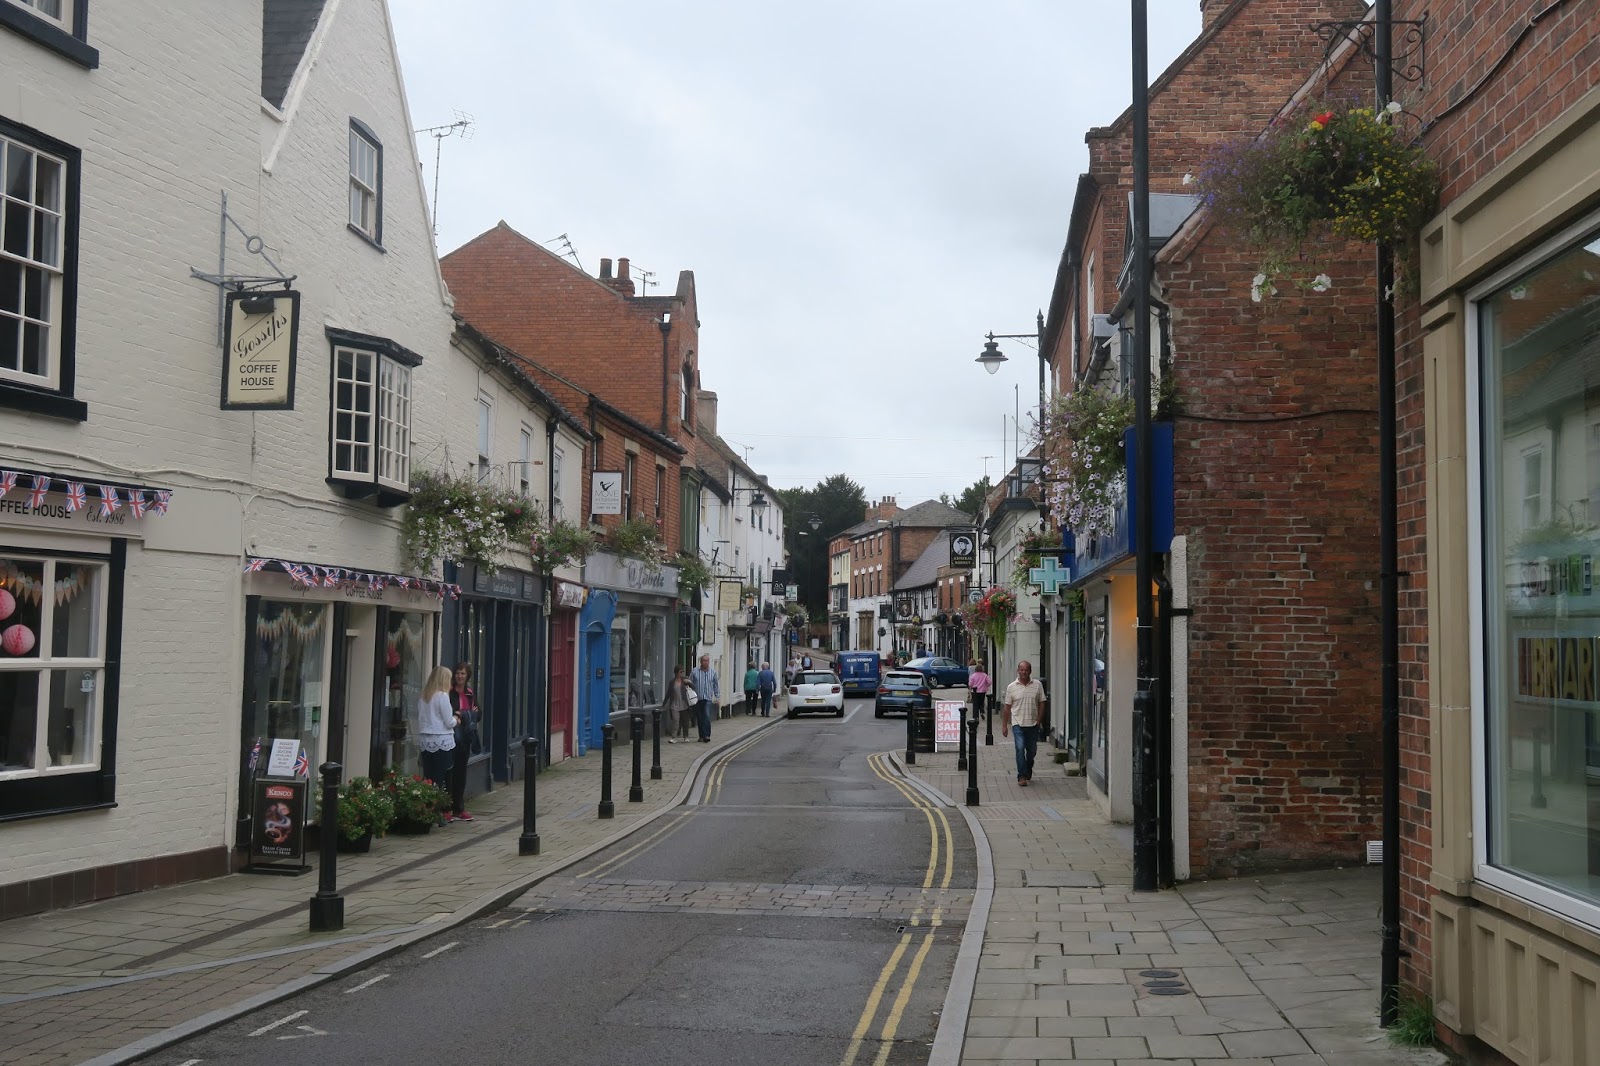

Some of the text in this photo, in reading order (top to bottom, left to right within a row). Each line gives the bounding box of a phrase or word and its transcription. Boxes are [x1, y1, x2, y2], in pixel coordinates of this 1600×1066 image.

[233, 314, 288, 358] Gossips
[239, 364, 277, 374] COFFEE
[240, 377, 275, 386] HOUSE
[32, 504, 71, 519] HOUSE
[105, 511, 125, 525] 1986
[1518, 637, 1600, 702] LIBRAR
[267, 789, 292, 798] KENCO
